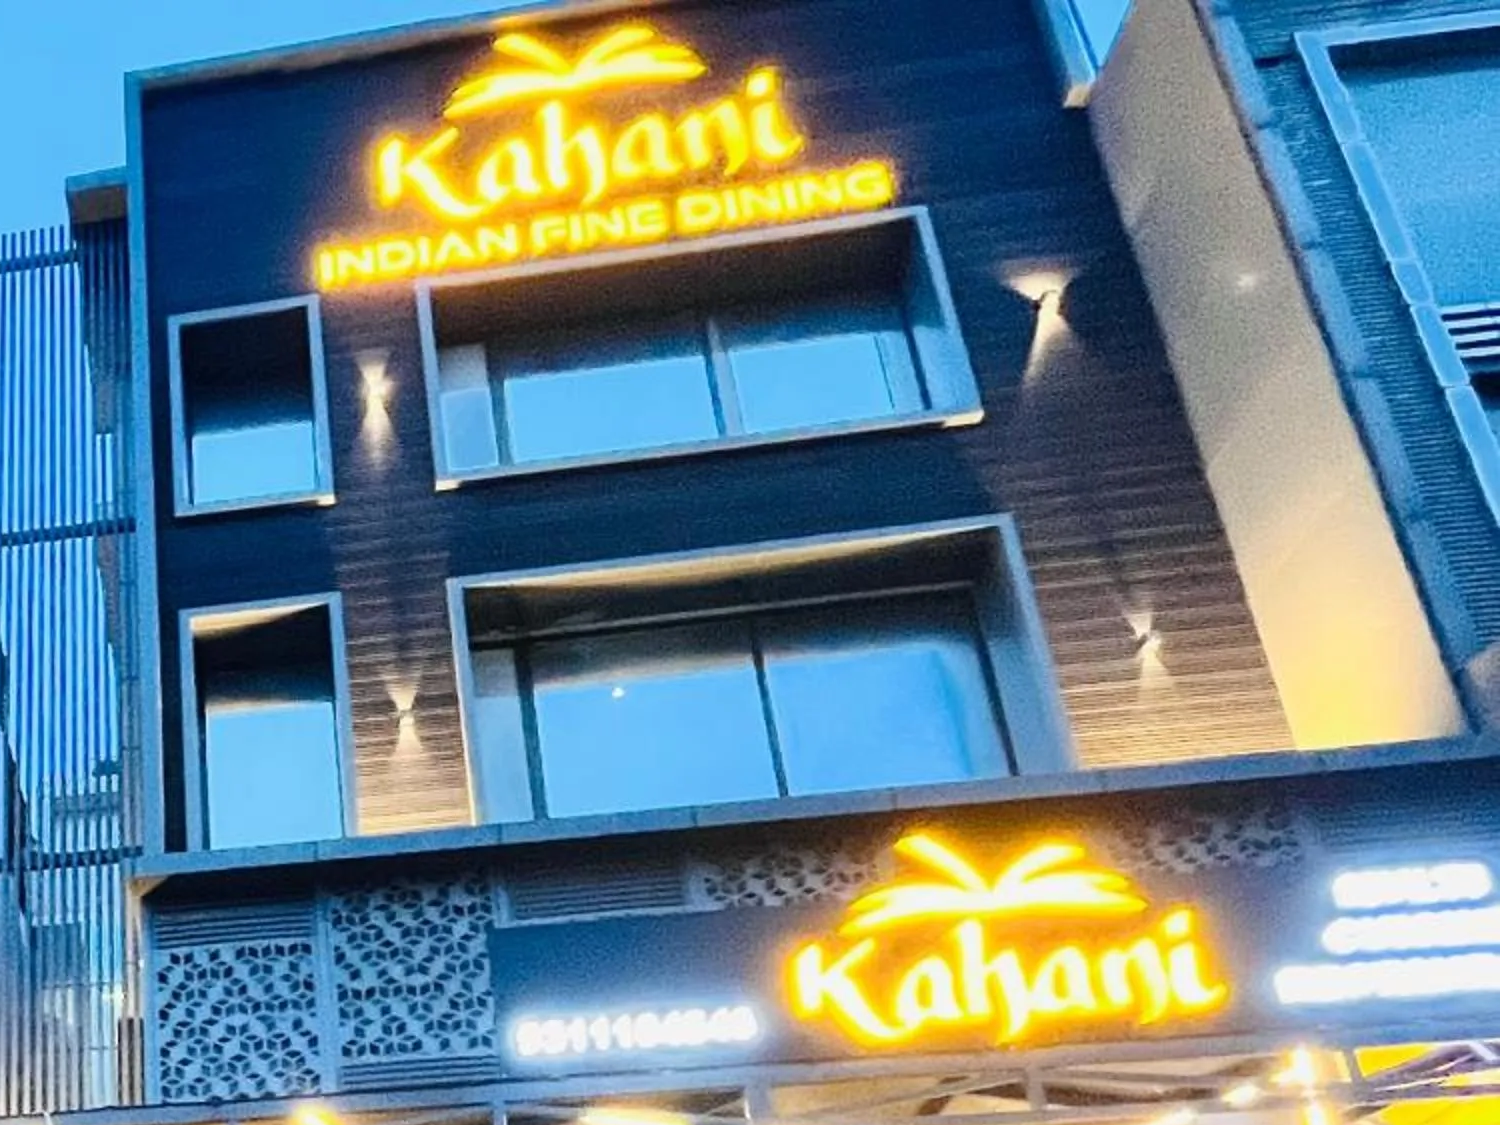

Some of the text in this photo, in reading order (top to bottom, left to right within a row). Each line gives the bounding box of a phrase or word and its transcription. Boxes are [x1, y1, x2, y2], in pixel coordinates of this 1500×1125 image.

[374, 66, 802, 222] Kahani
[317, 161, 894, 289] INDIAN FINE DINING
[793, 908, 1228, 1044] Kahani
